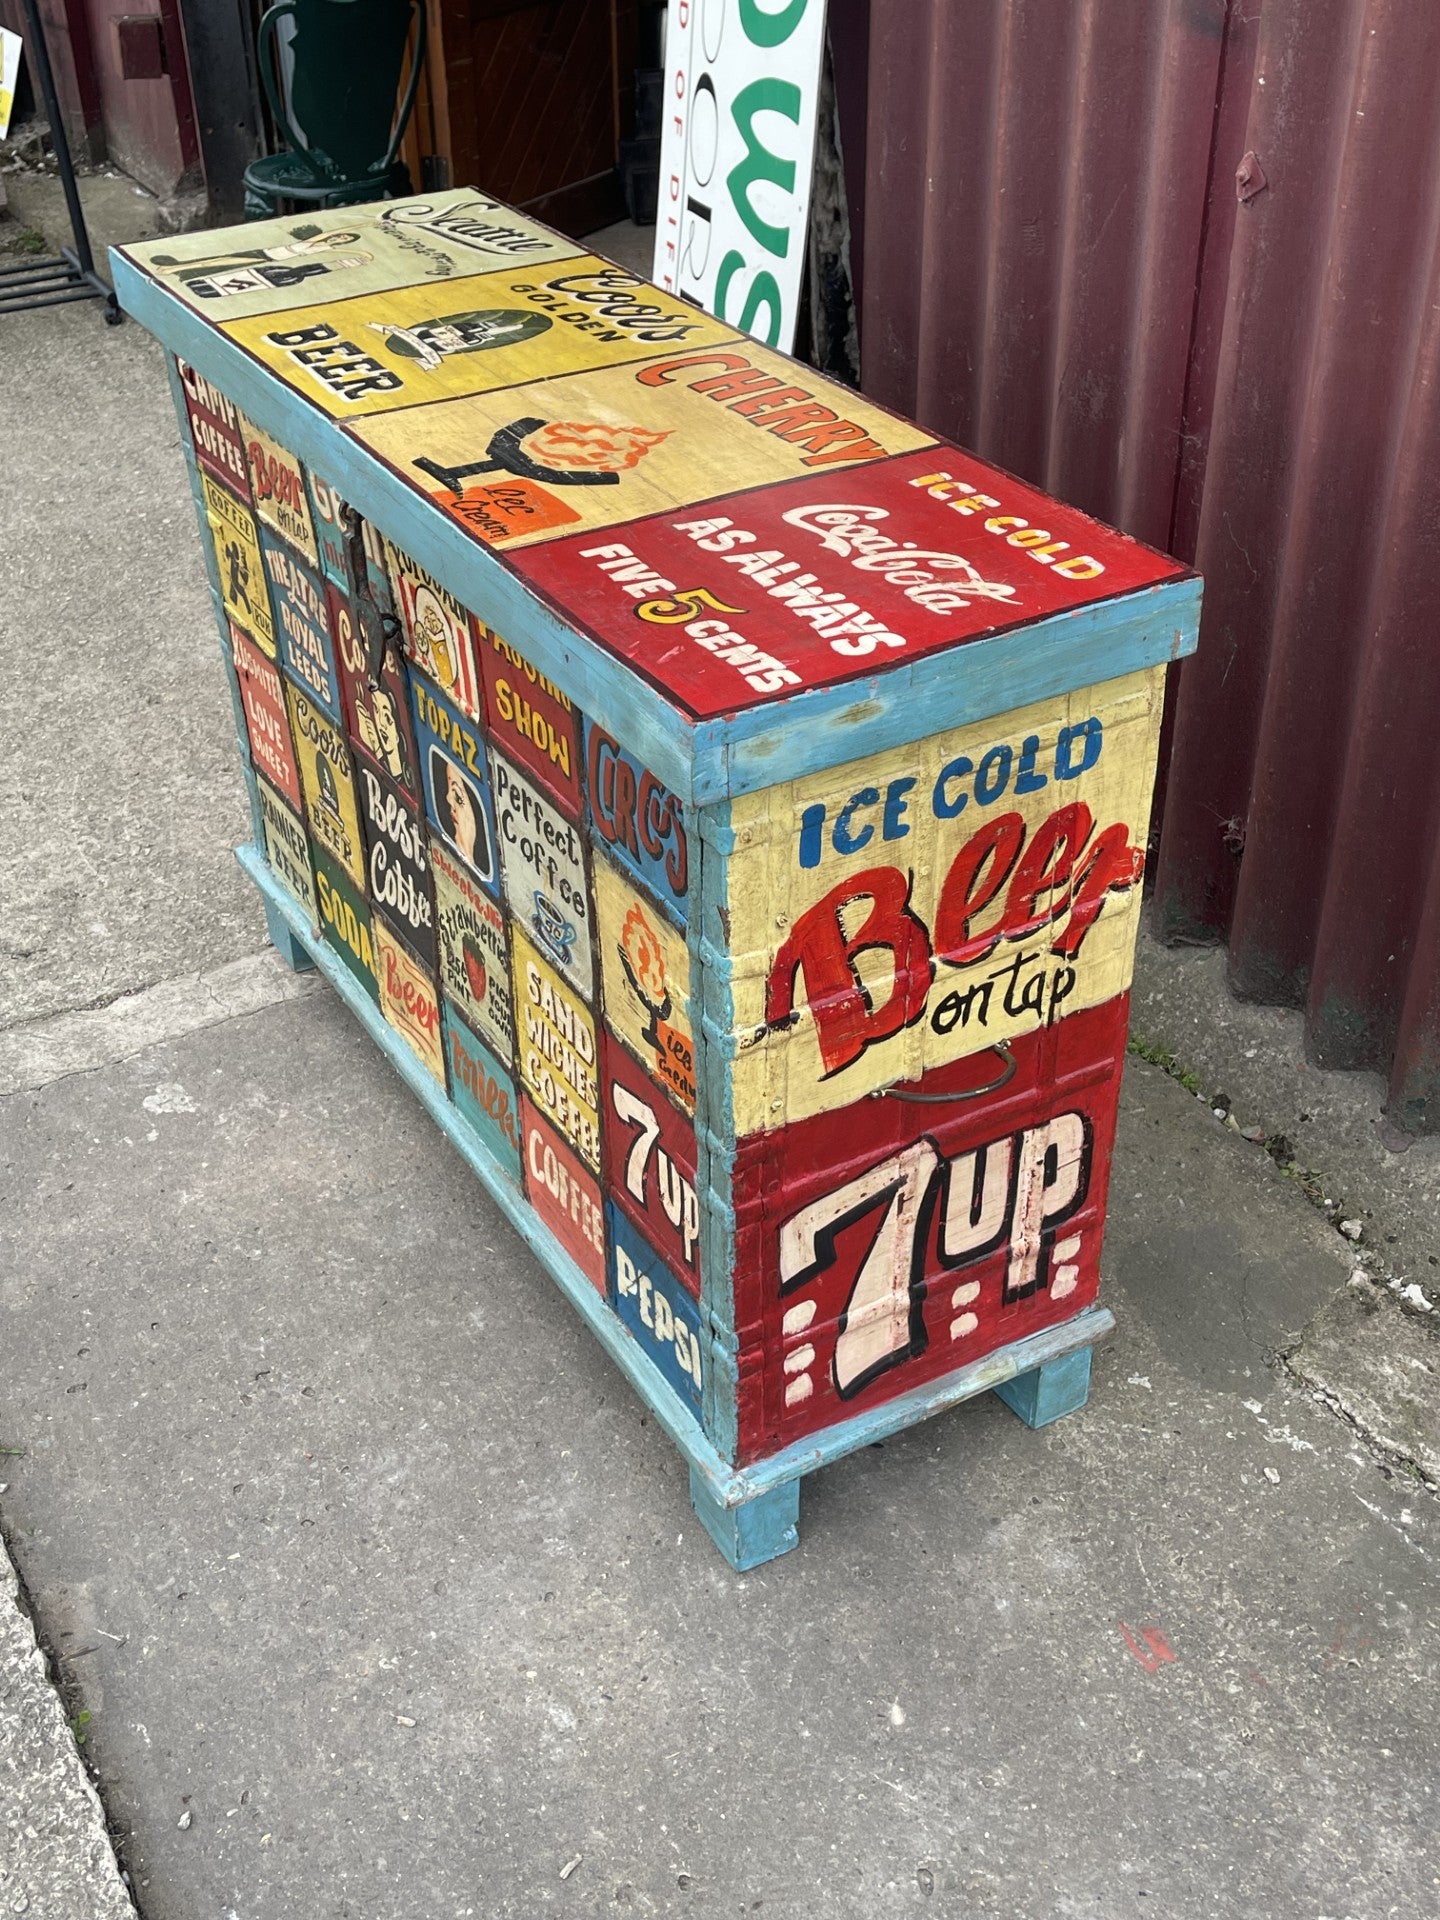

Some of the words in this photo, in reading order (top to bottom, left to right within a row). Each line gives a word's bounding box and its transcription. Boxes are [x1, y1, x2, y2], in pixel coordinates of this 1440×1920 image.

[674, 70, 686, 137] OF
[510, 283, 627, 343] GOLDEN
[543, 269, 704, 343] Coors
[262, 322, 404, 402] BEER
[191, 413, 246, 481] COFFEE
[635, 353, 889, 467] CHERRY
[211, 489, 252, 538] COFFEE
[248, 440, 304, 518] Beer
[908, 471, 1001, 516] ICE
[984, 516, 1105, 580] COLD
[265, 548, 328, 634] THEATRE
[578, 543, 677, 599] FIVE
[633, 586, 750, 625] 5
[672, 516, 757, 552] AS
[720, 549, 907, 657] ALWAYS
[280, 600, 329, 673] ROYAL
[287, 640, 331, 704] LEEDS
[684, 619, 803, 693] CENTS
[247, 690, 285, 752] LOVE
[252, 727, 290, 786] SWEET
[295, 694, 350, 778] Coors
[413, 680, 482, 779] TOPAZ
[495, 678, 571, 778] SHOW
[362, 767, 426, 873] Best
[496, 763, 580, 867] Perfect
[798, 775, 918, 869] ICE
[931, 716, 1104, 820] COLD
[272, 839, 312, 906] BEER
[310, 803, 354, 868] BEER
[316, 870, 377, 977] SODA
[764, 800, 1147, 1083] Beer
[381, 945, 440, 1042] Beer
[525, 959, 595, 1069] SAND
[523, 1003, 599, 1112] WICHES
[528, 1128, 605, 1256] COFFEE
[615, 1243, 702, 1391] PEPSI
